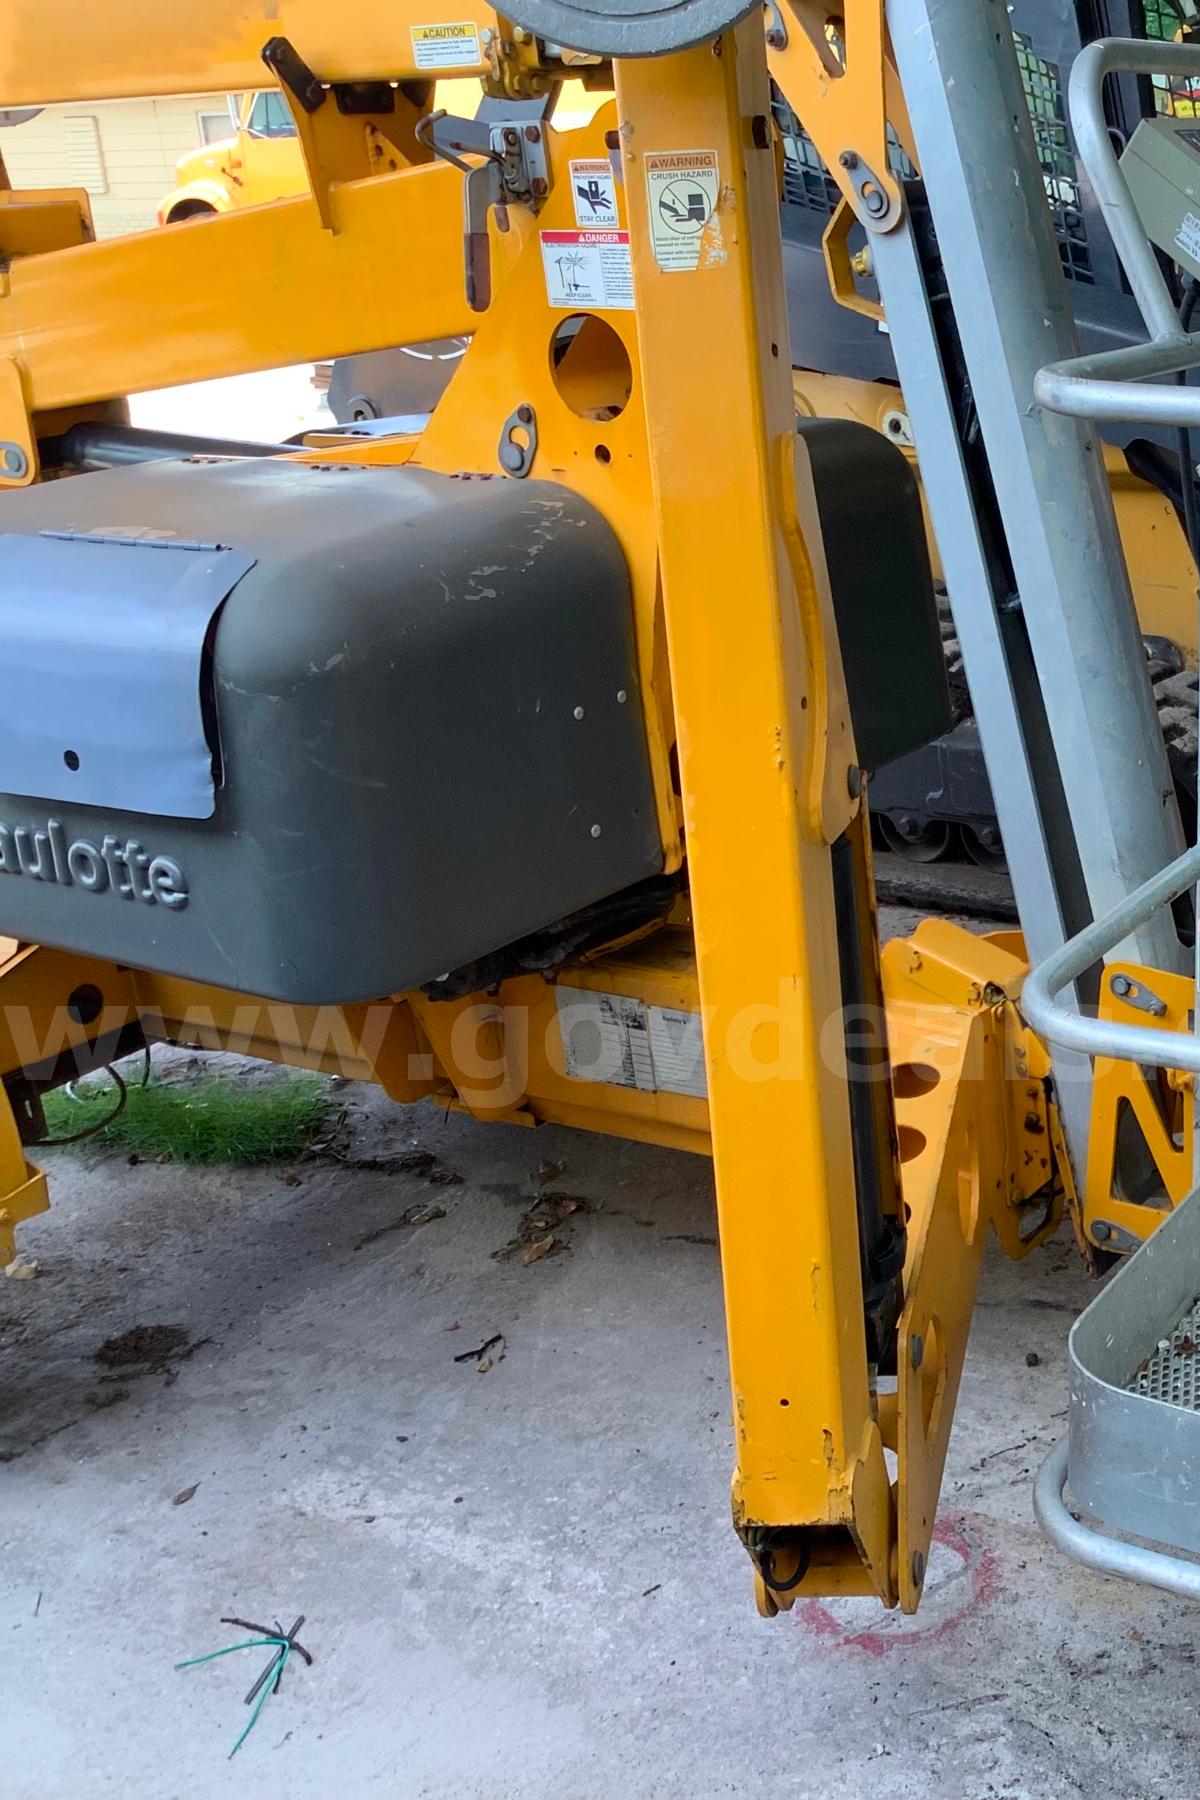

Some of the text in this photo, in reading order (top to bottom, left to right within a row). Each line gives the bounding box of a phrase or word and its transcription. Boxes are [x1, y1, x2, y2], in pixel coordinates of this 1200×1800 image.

[429, 26, 466, 38] CAUTION
[658, 155, 712, 168] WARNING
[651, 170, 713, 180] CRUSH HAZARD
[595, 215, 615, 223] CLEAR
[585, 232, 620, 243] DANGER
